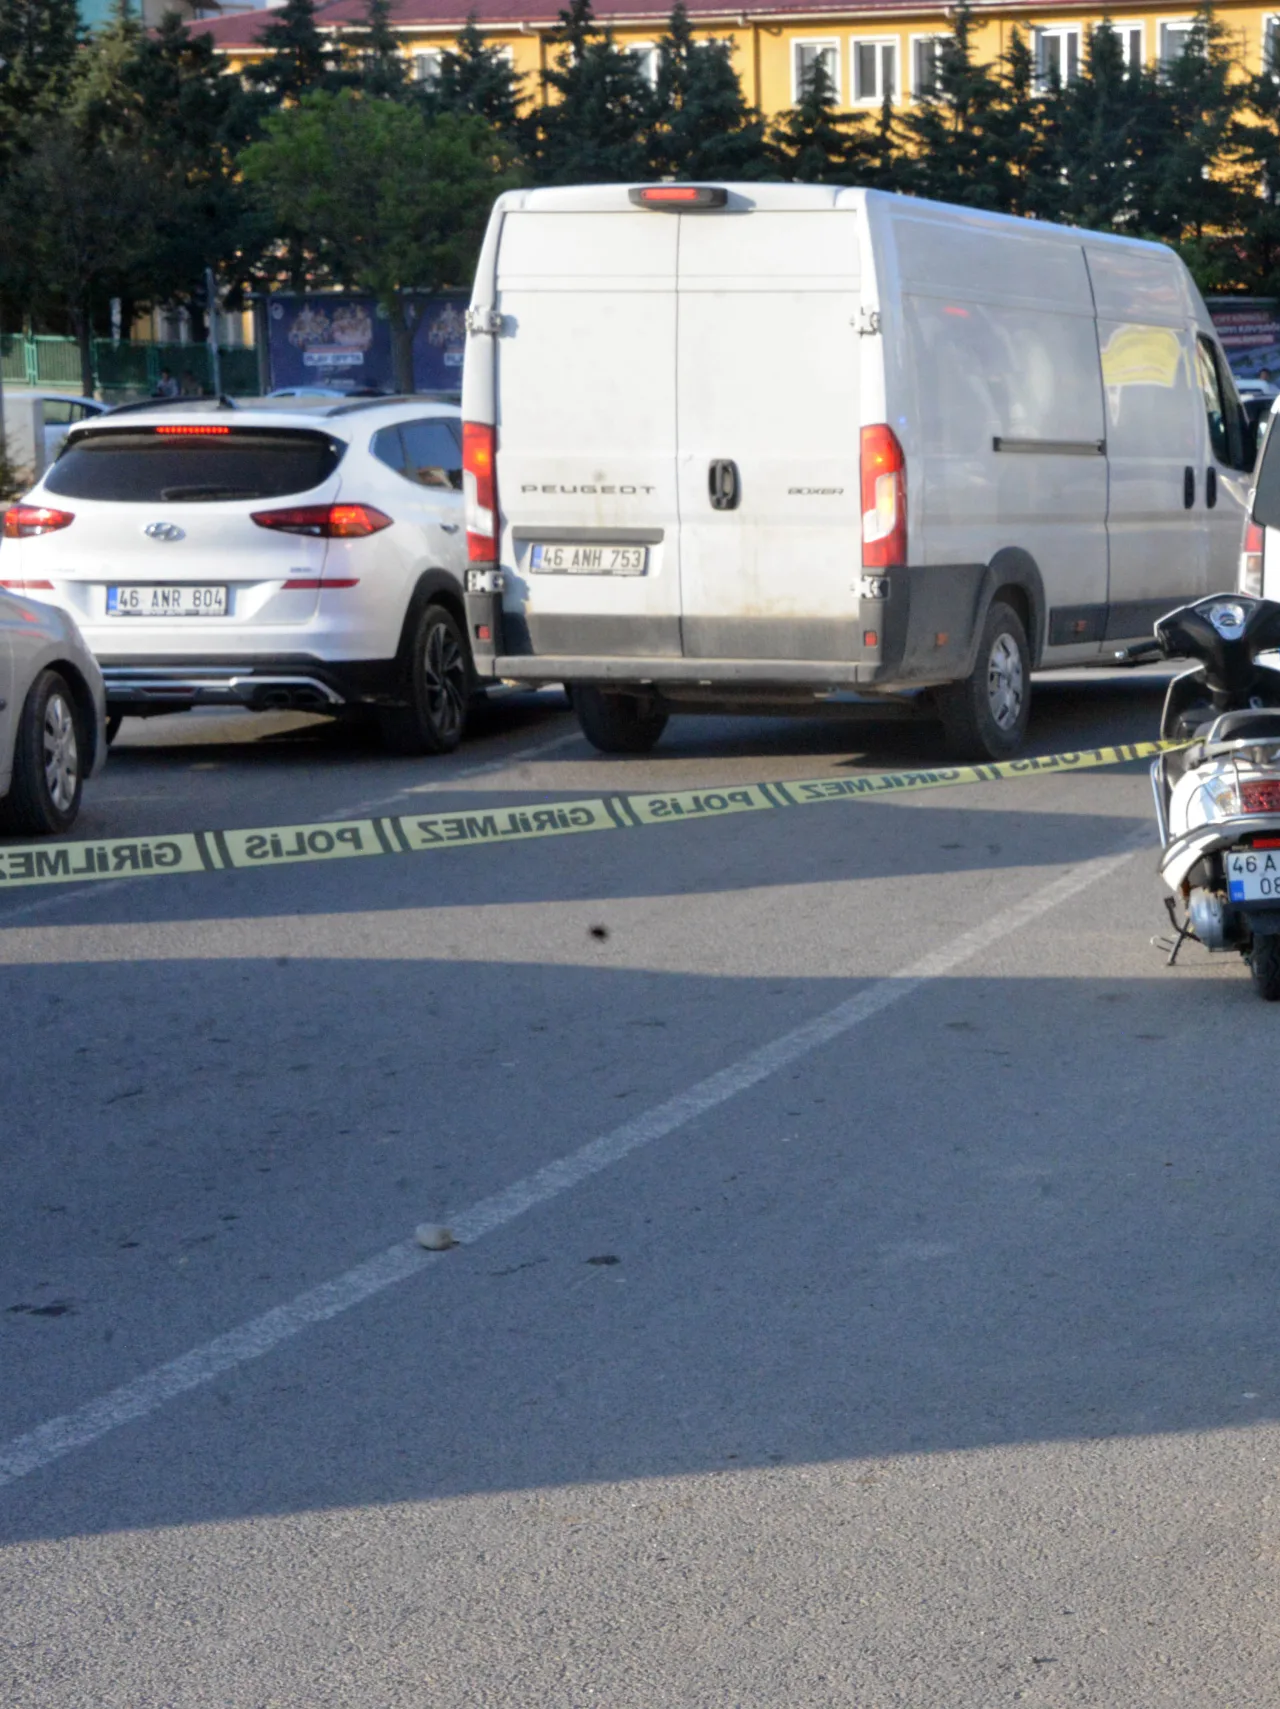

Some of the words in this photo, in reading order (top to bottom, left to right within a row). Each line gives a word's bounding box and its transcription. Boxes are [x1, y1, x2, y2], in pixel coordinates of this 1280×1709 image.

[520, 484, 656, 495] PEUGEOT
[542, 548, 564, 568] 46
[572, 548, 603, 568] ANH
[610, 549, 642, 569] 753
[119, 589, 139, 609] 46
[151, 589, 182, 609] ANR
[192, 588, 223, 608] 804
[1232, 855, 1257, 874] 46
